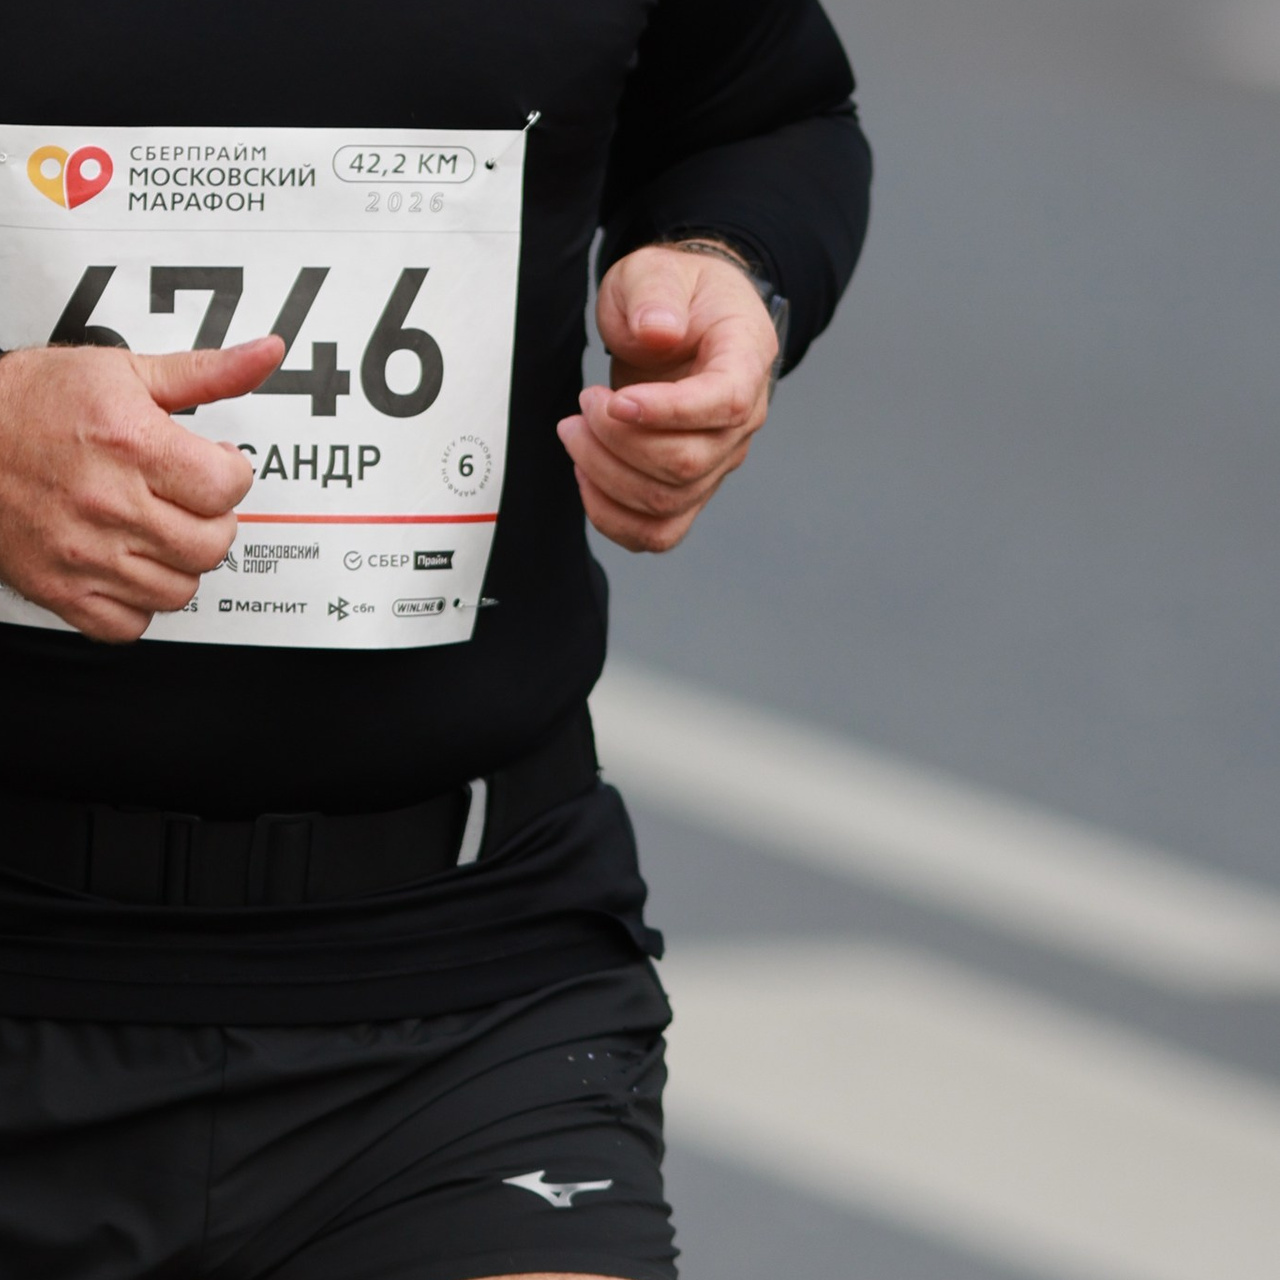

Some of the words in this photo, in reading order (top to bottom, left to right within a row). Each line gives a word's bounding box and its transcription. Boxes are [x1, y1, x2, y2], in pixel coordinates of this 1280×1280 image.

[129, 142, 267, 161] СБЕРПРАЙМ
[348, 152, 407, 177] 42,2
[418, 153, 459, 174] КМ
[128, 163, 317, 187] МОСКОВСКИЙ
[128, 191, 266, 212] МАРАФОН
[364, 191, 445, 213] 2026
[458, 453, 475, 477] 6
[243, 542, 320, 560] МОСКОВСКИЙ
[243, 559, 279, 574] СПОРТ
[367, 554, 410, 568] СБЕР
[417, 554, 448, 569] Прайм
[235, 600, 308, 614] магнит
[397, 601, 436, 614] WINLINE
